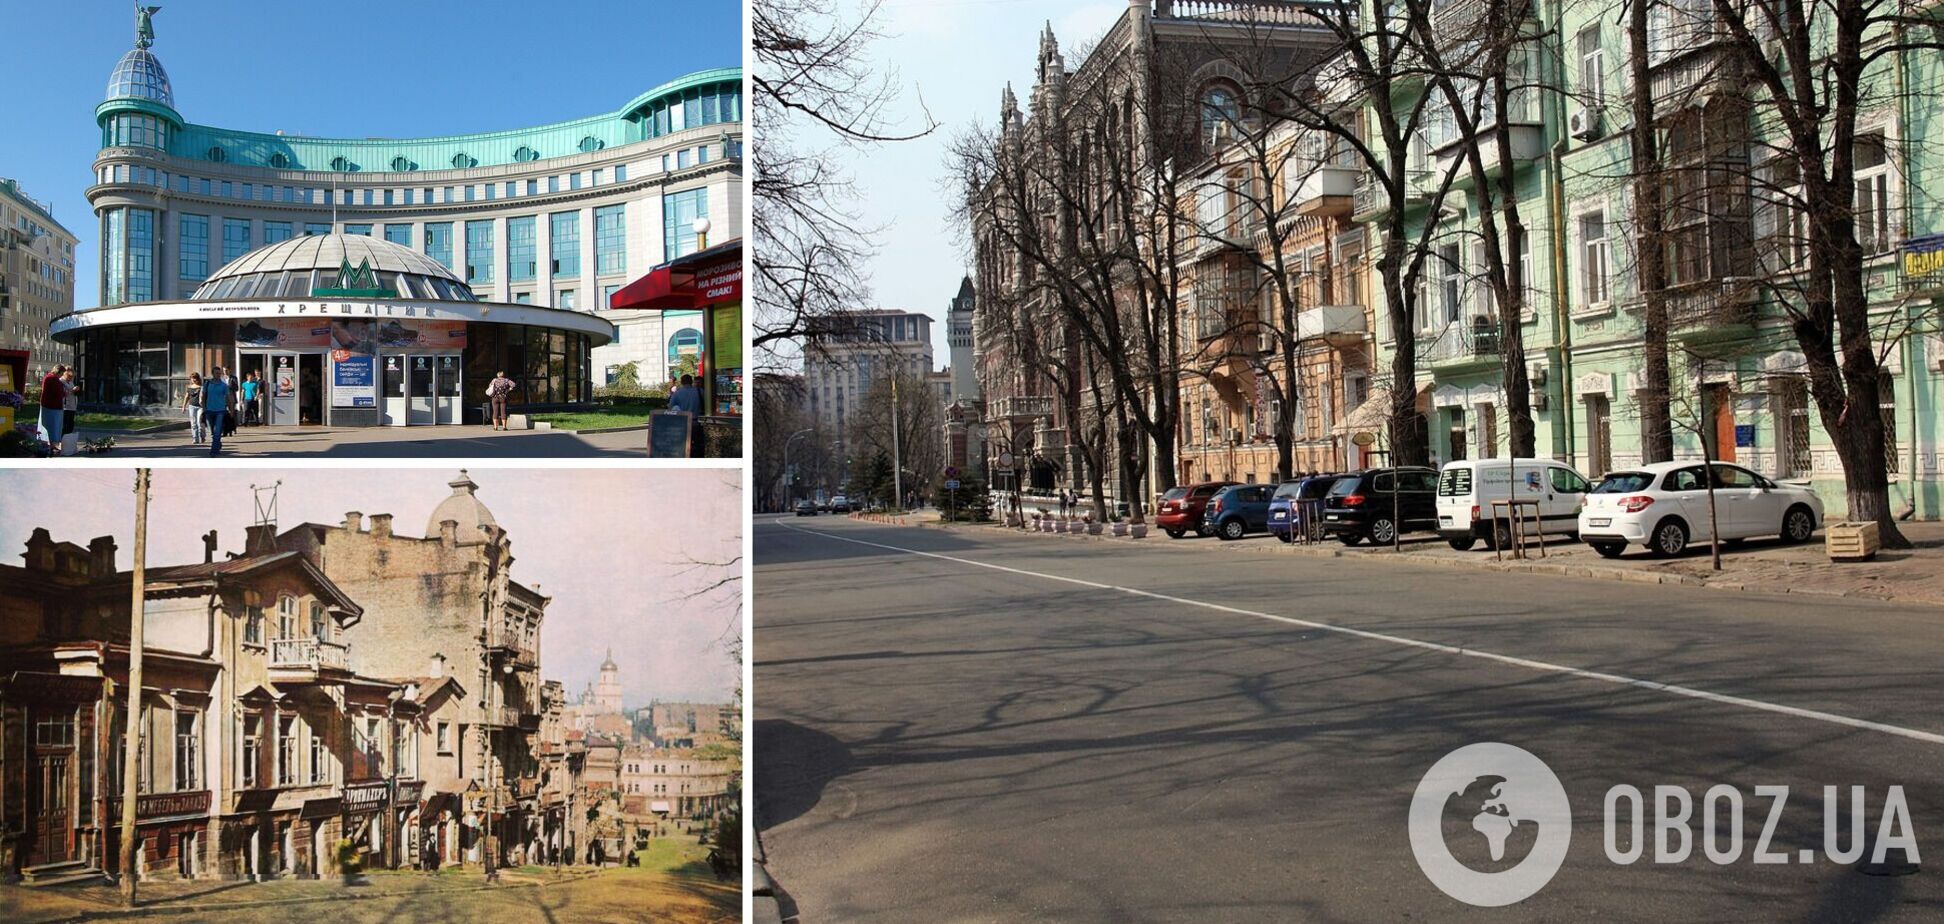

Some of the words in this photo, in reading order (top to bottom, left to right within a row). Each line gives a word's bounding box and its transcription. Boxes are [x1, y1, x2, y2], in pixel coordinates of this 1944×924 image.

[698, 280, 709, 289] НА
[711, 270, 742, 286] РІЗНИЙ
[706, 286, 732, 298] СМАК!
[278, 303, 434, 317] ХРЕЩАТИК
